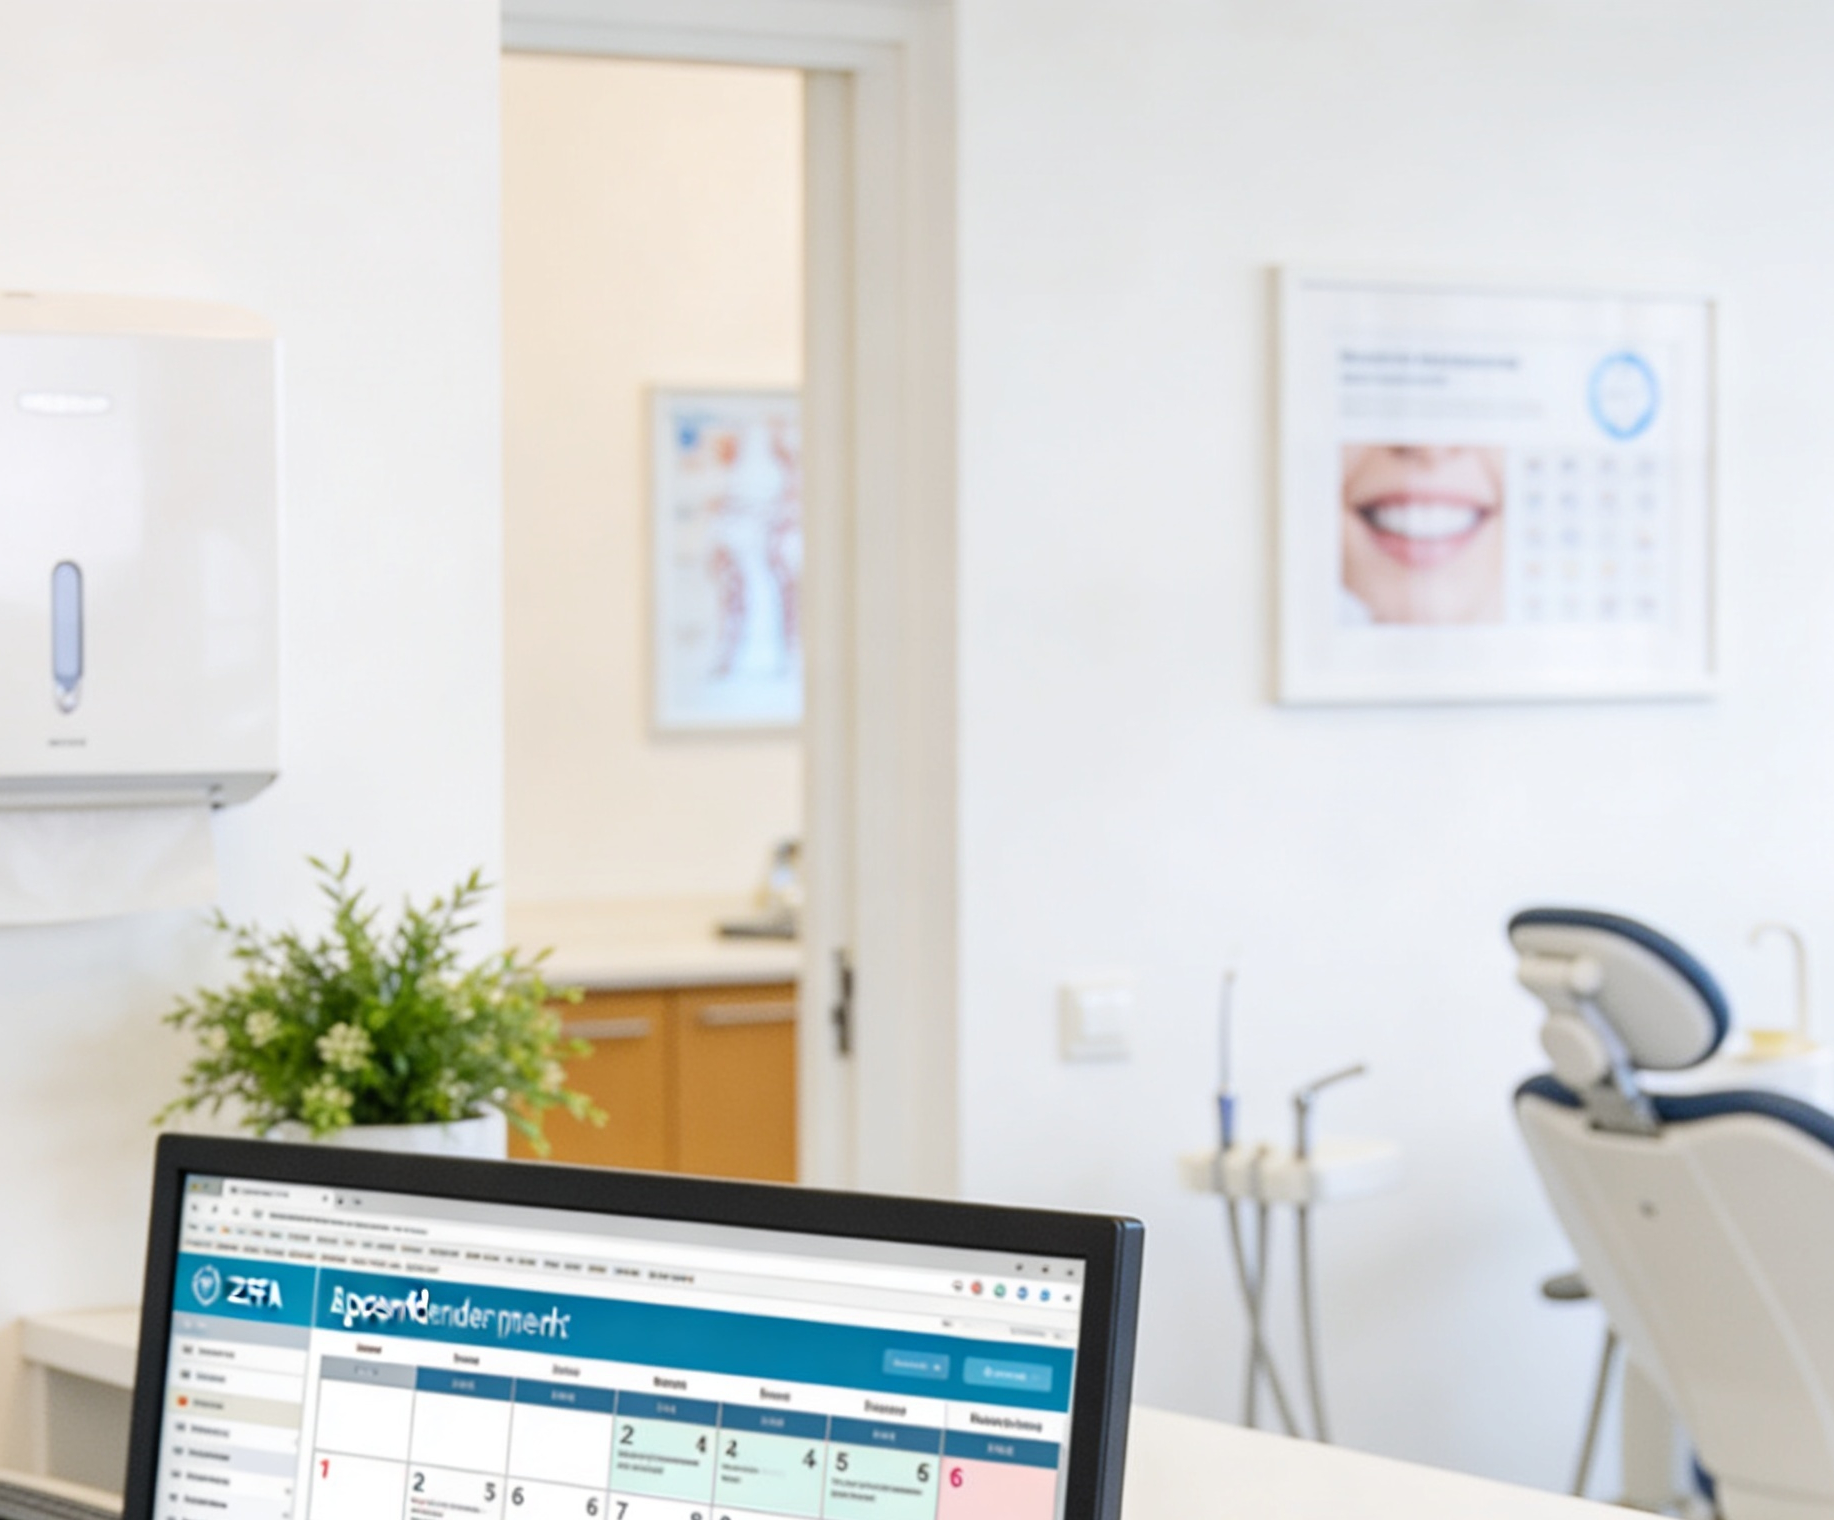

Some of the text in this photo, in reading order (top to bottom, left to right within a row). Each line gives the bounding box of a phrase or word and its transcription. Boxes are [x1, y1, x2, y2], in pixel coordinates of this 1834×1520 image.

[619, 1424, 635, 1445] 2
[413, 1472, 425, 1492] 2
[949, 1467, 963, 1488] 6
[511, 1486, 525, 1507] 6
[586, 1497, 599, 1517] 6
